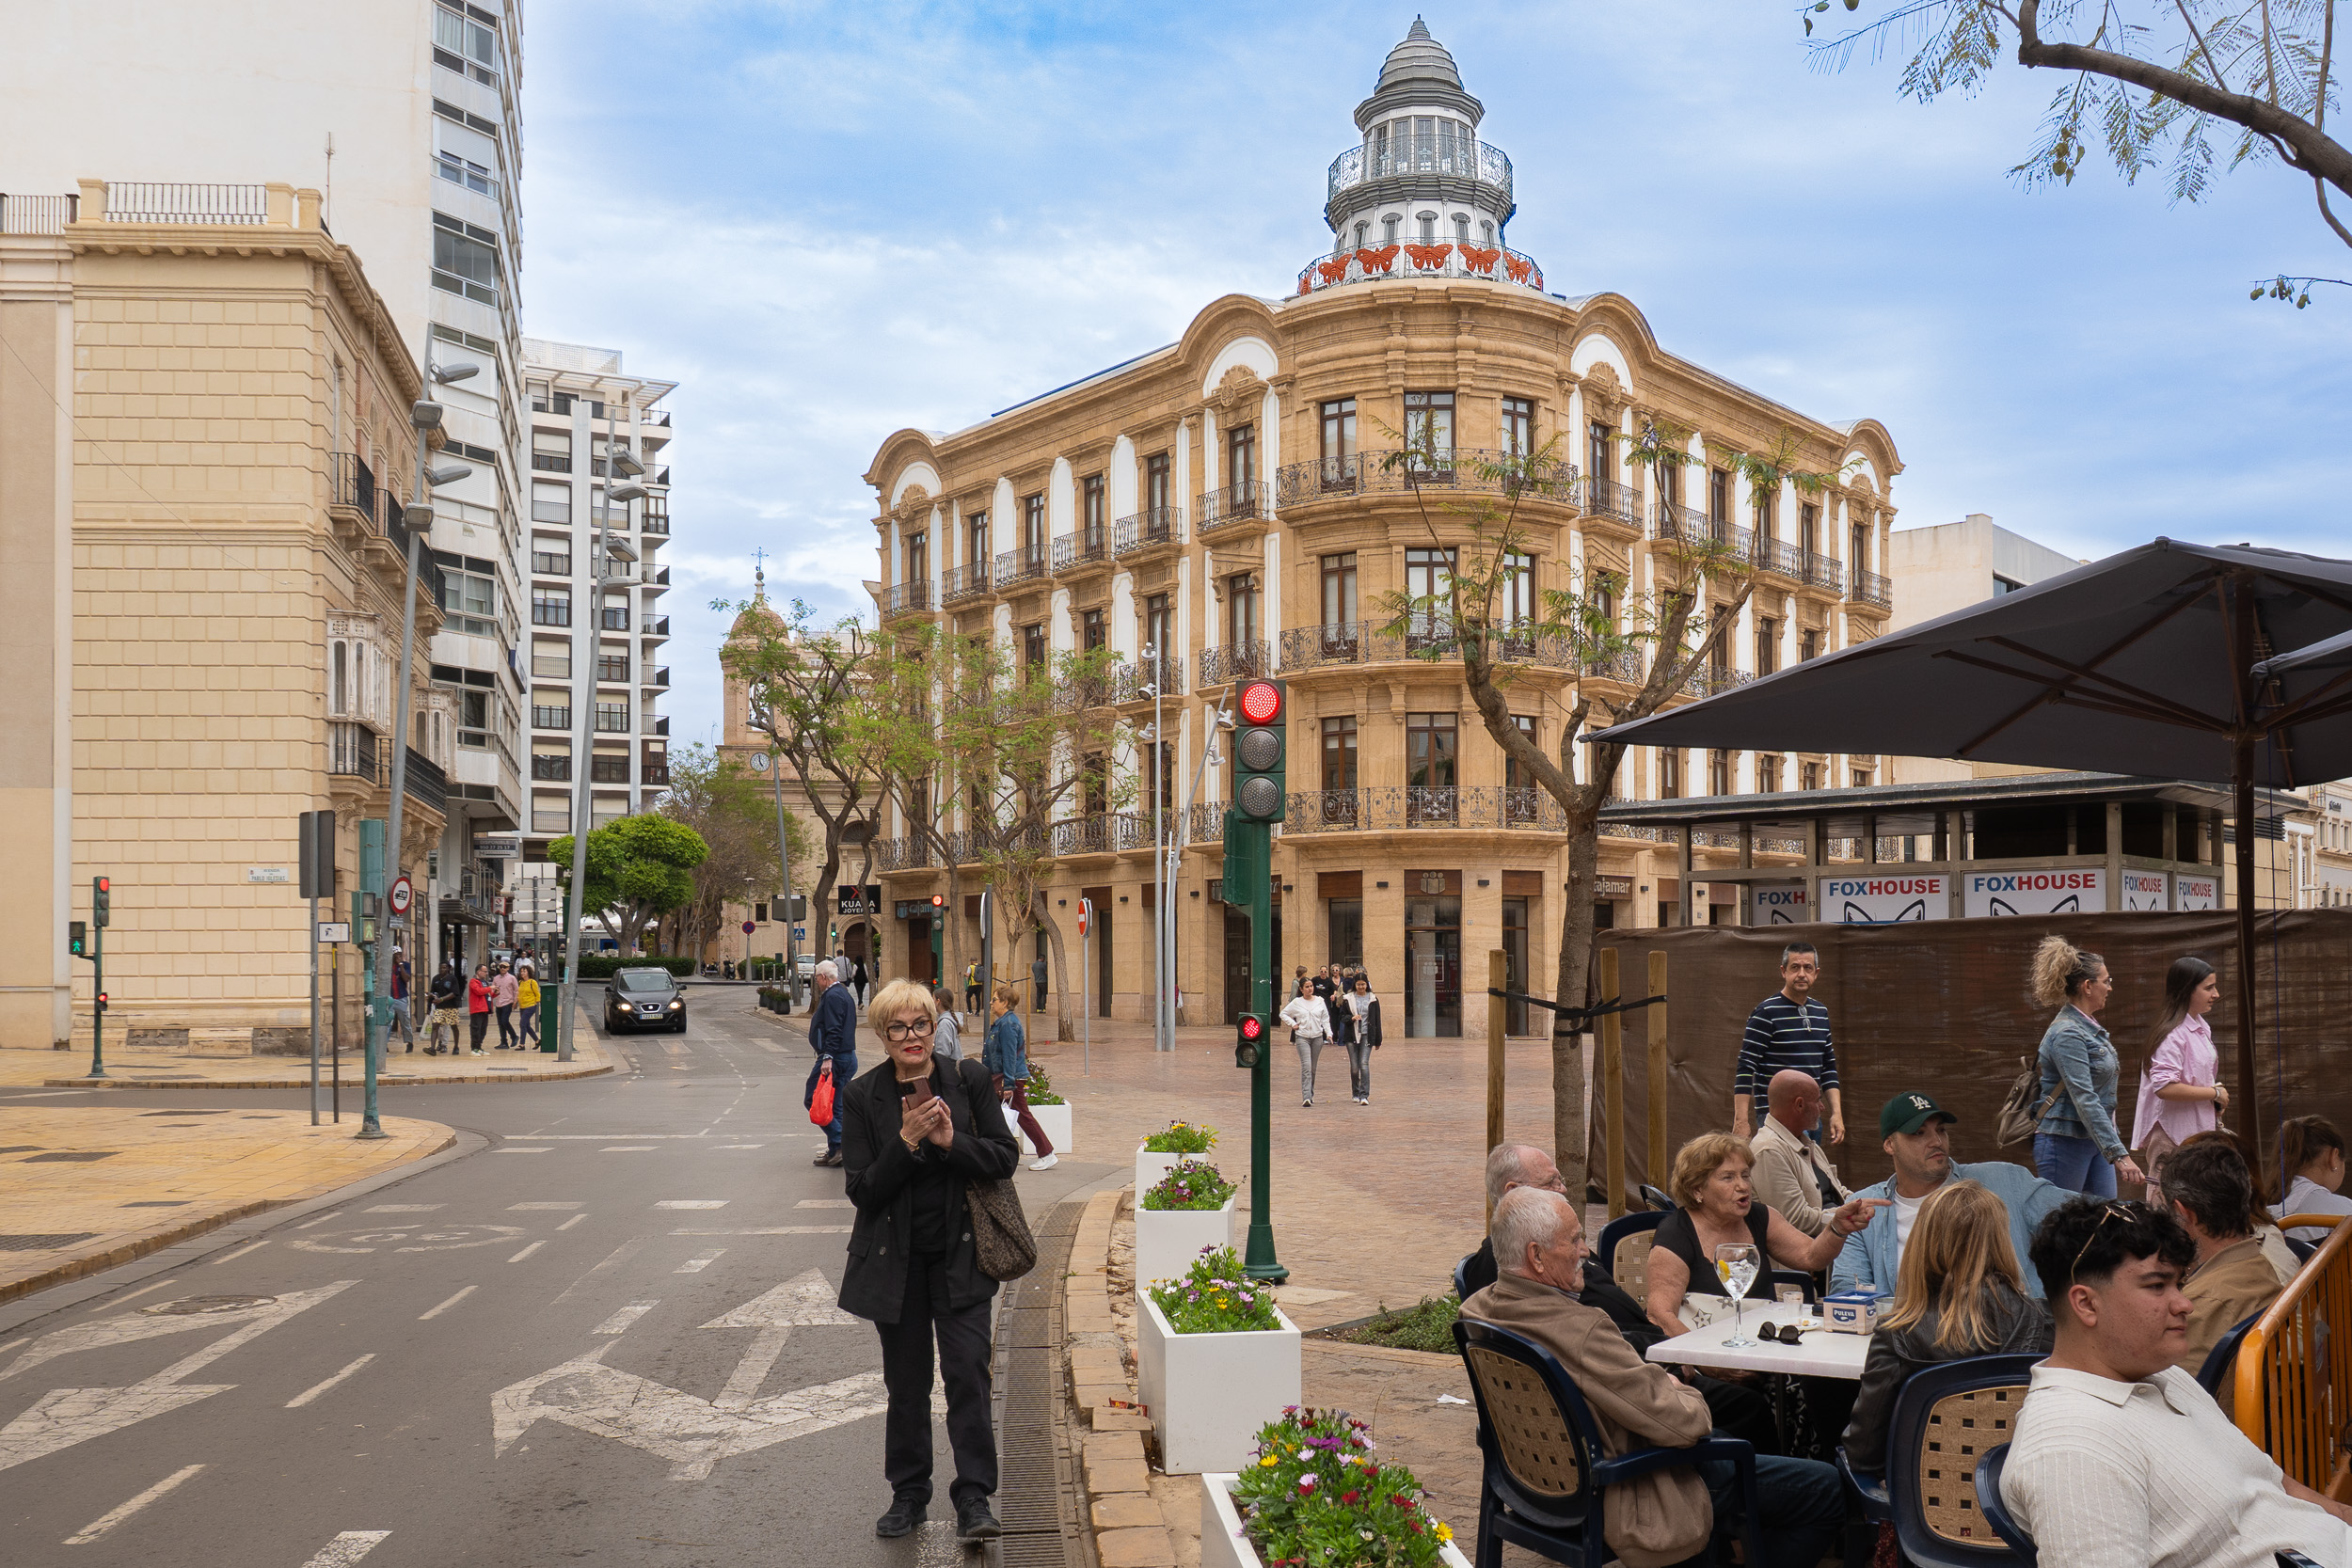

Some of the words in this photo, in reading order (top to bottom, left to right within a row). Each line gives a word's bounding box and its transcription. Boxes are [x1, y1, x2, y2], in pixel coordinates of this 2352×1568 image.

[1829, 879, 1941, 896] FOXHOUSE
[1974, 873, 2096, 893] FOXHOUSE
[2124, 875, 2162, 893] FOXHOUSE
[2178, 881, 2212, 897] FOXHOUSE
[1757, 891, 1805, 905] FOXH
[909, 900, 932, 917] cajam
[1909, 1095, 1931, 1110] LA
